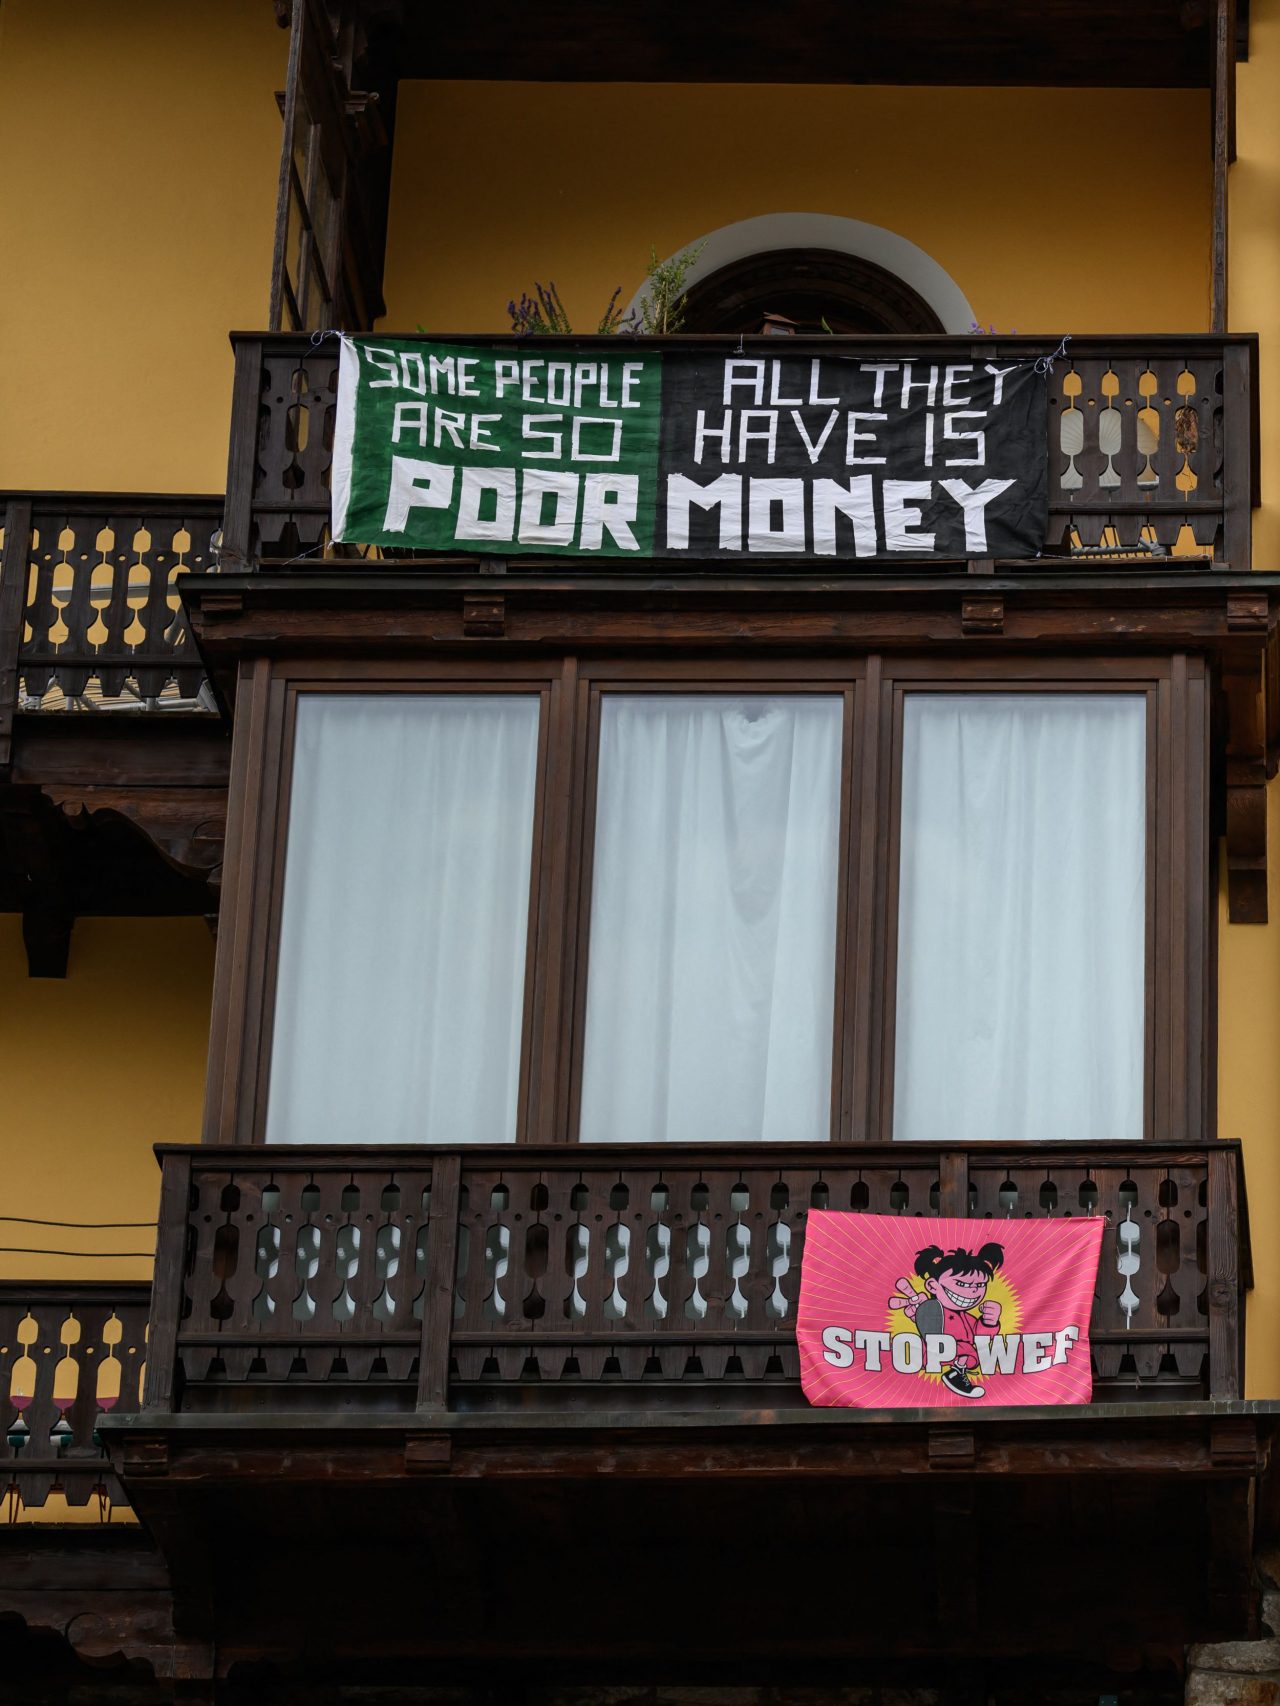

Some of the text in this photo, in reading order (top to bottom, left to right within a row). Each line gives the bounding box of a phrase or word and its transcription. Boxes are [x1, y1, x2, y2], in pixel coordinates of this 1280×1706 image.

[364, 345, 644, 408] SOME PEOPLE
[723, 358, 1022, 408] ALL THEY
[392, 401, 622, 461] ARE SO
[694, 409, 987, 467] HAVE IS
[382, 455, 640, 550] POOR
[666, 472, 1017, 557] MONEY
[822, 1325, 1080, 1375] STOP WEF
